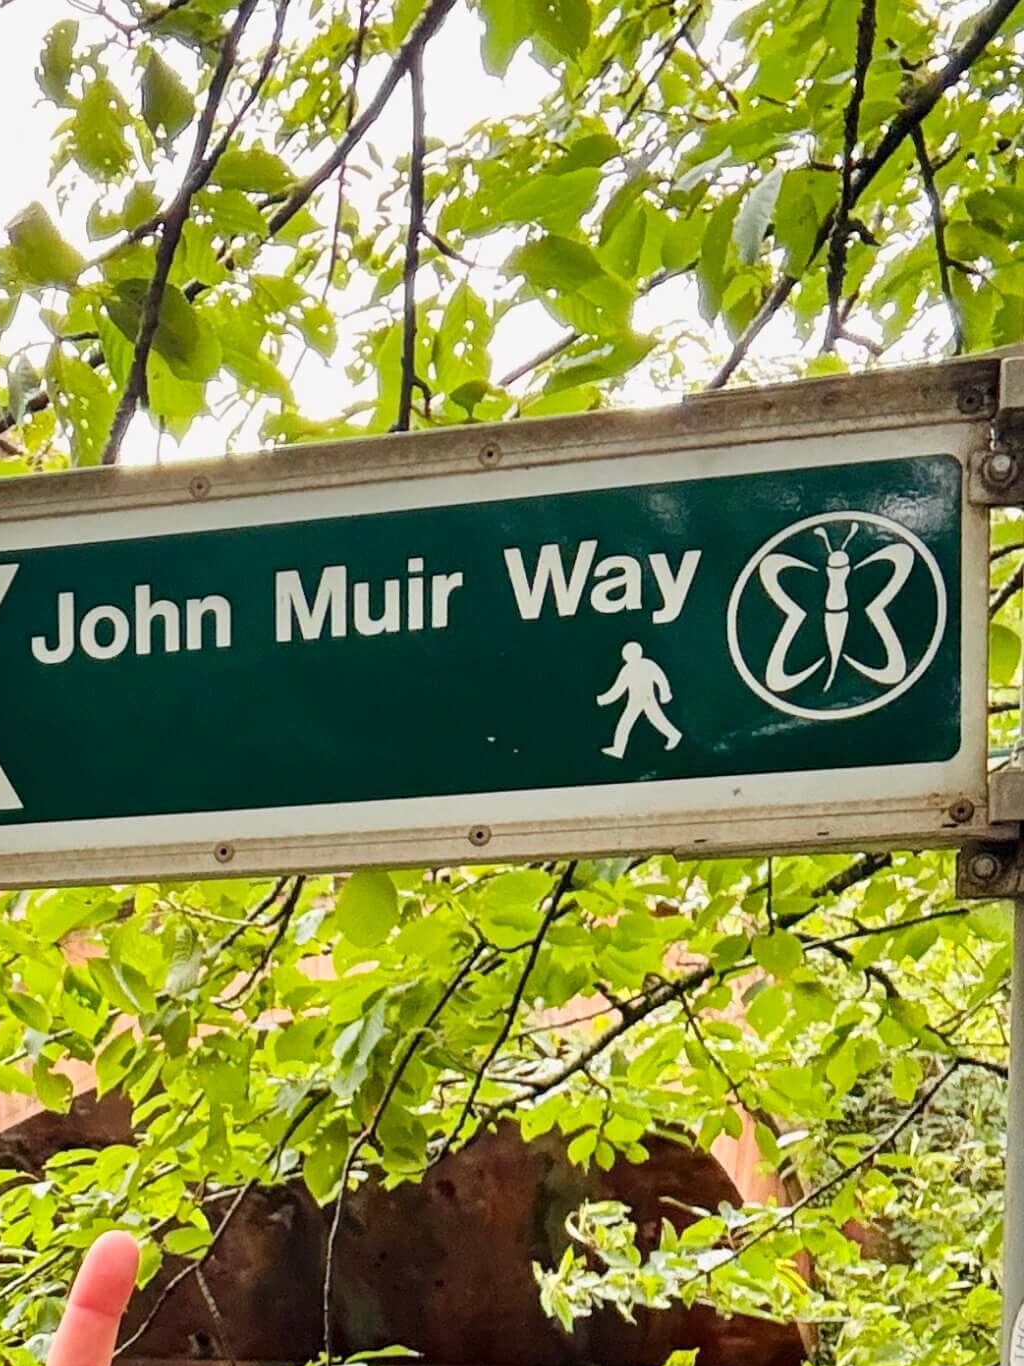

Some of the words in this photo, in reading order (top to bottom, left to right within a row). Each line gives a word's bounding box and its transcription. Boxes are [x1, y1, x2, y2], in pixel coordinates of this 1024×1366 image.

[31, 584, 232, 665] John
[275, 557, 464, 642] Muir
[503, 539, 703, 625] Way
